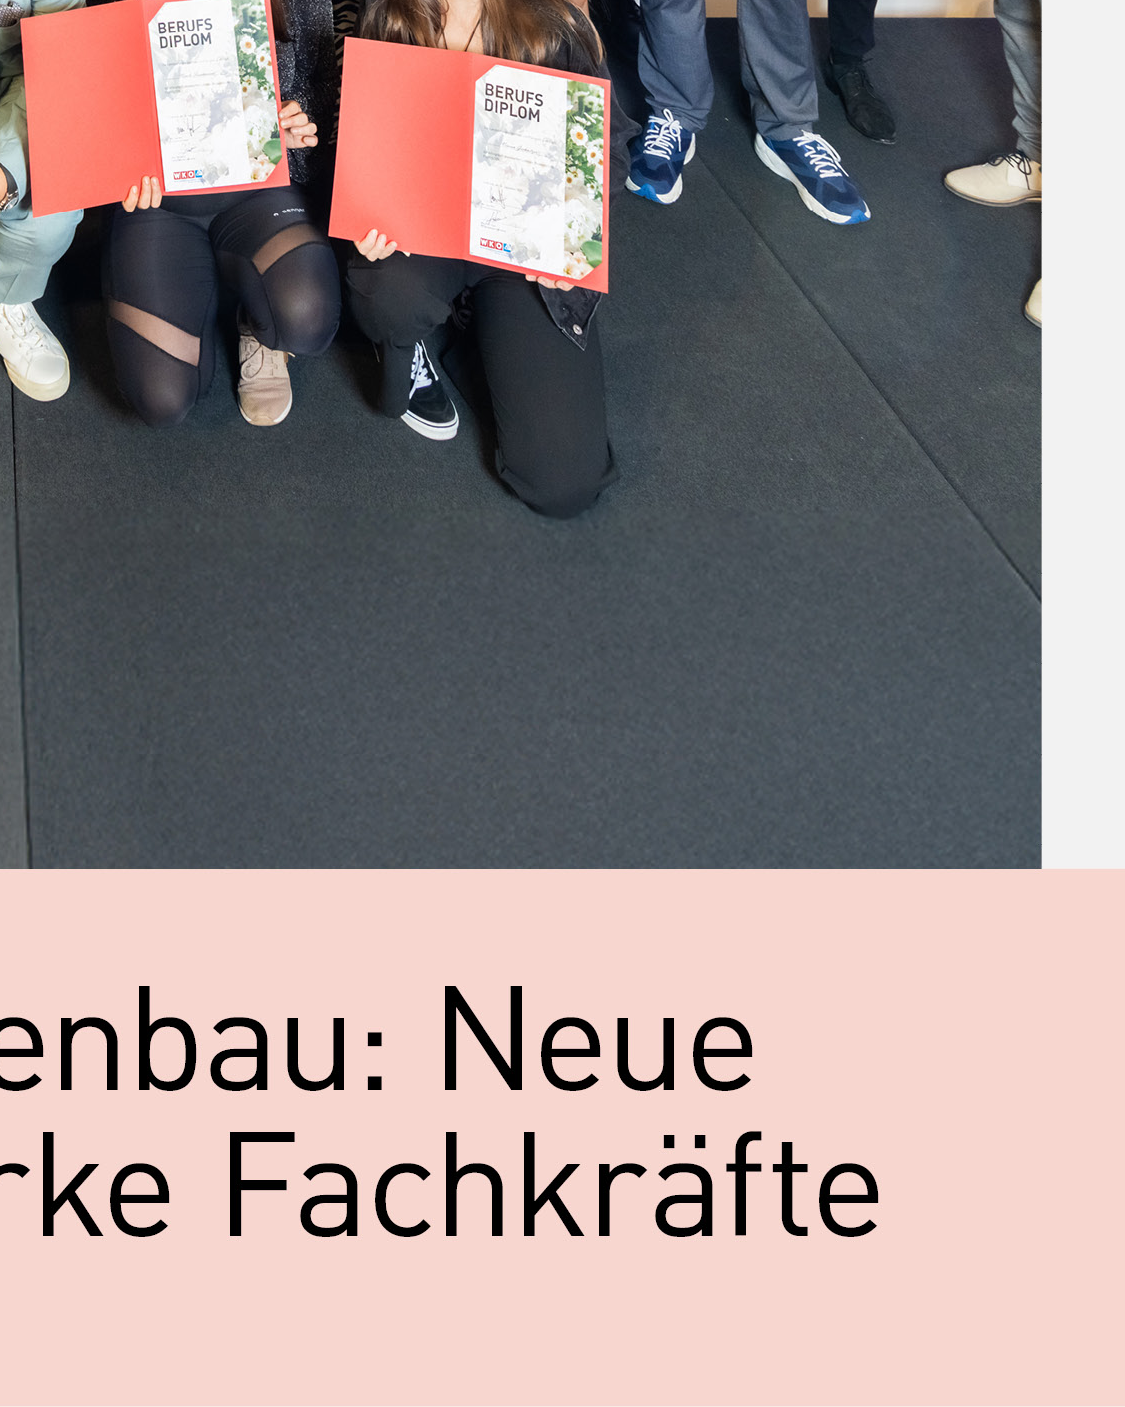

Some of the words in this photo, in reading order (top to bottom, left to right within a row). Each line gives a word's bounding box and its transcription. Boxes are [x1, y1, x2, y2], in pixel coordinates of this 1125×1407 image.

[158, 18, 213, 34] BERUFS
[159, 32, 212, 49] DIPLOM
[485, 83, 543, 107] BERUFS
[484, 98, 540, 122] DIPLOM
[174, 171, 195, 180] WKO
[480, 238, 503, 251] WKO
